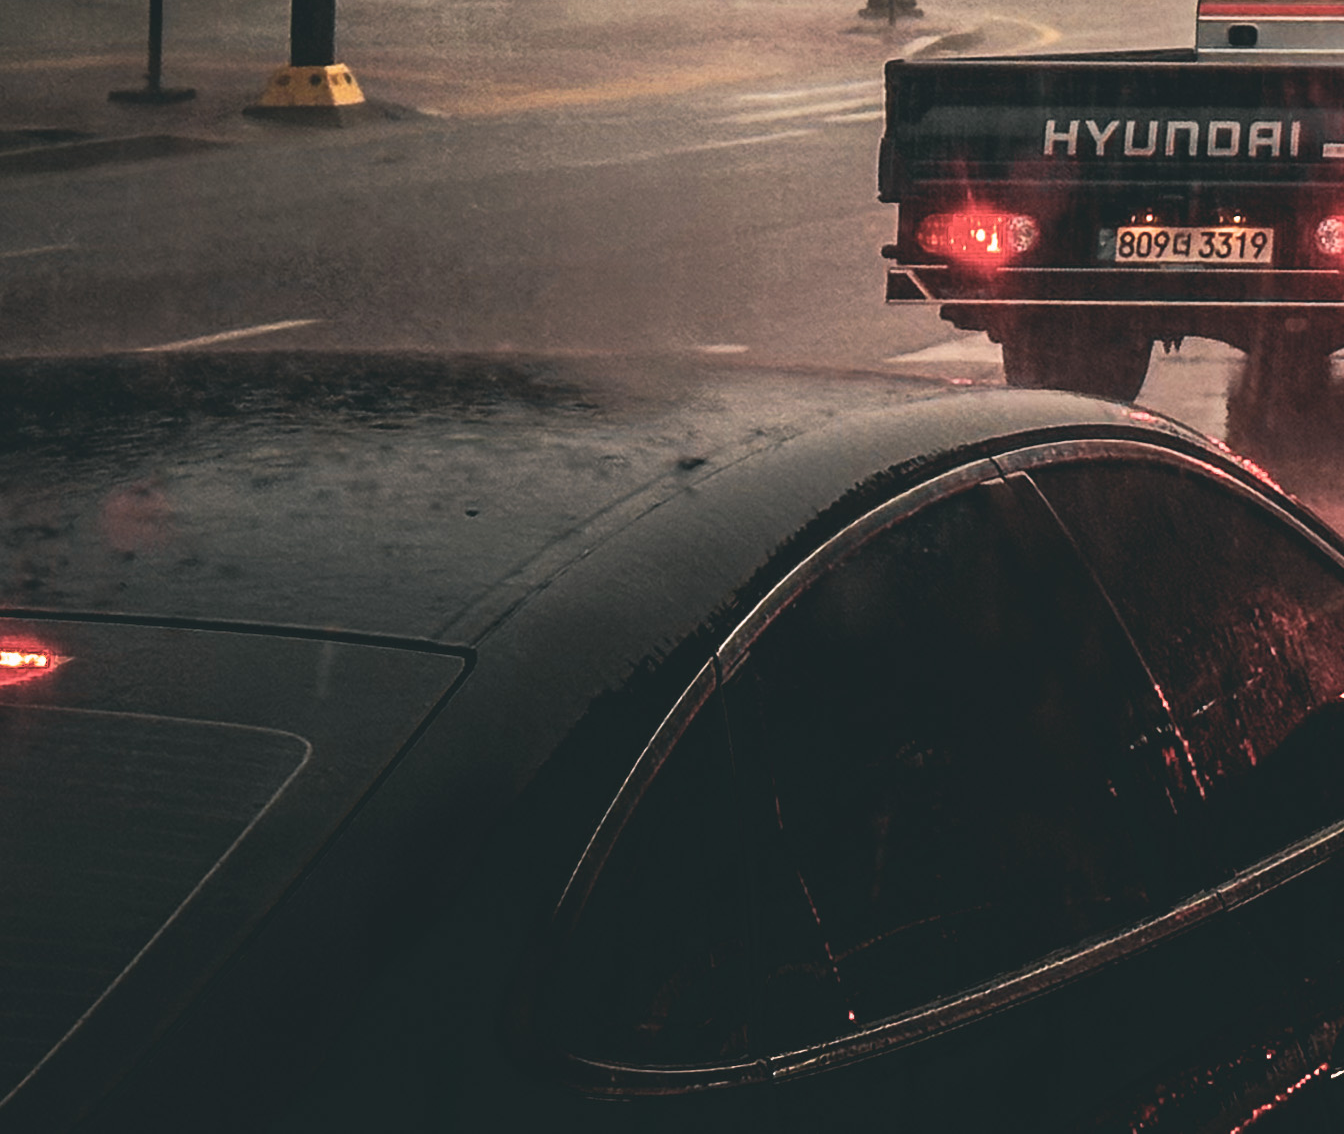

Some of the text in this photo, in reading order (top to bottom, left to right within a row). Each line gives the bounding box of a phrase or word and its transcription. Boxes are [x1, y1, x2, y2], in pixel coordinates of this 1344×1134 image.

[1042, 119, 1301, 157] HYUNDAI
[1118, 230, 1269, 260] 809더 3319
